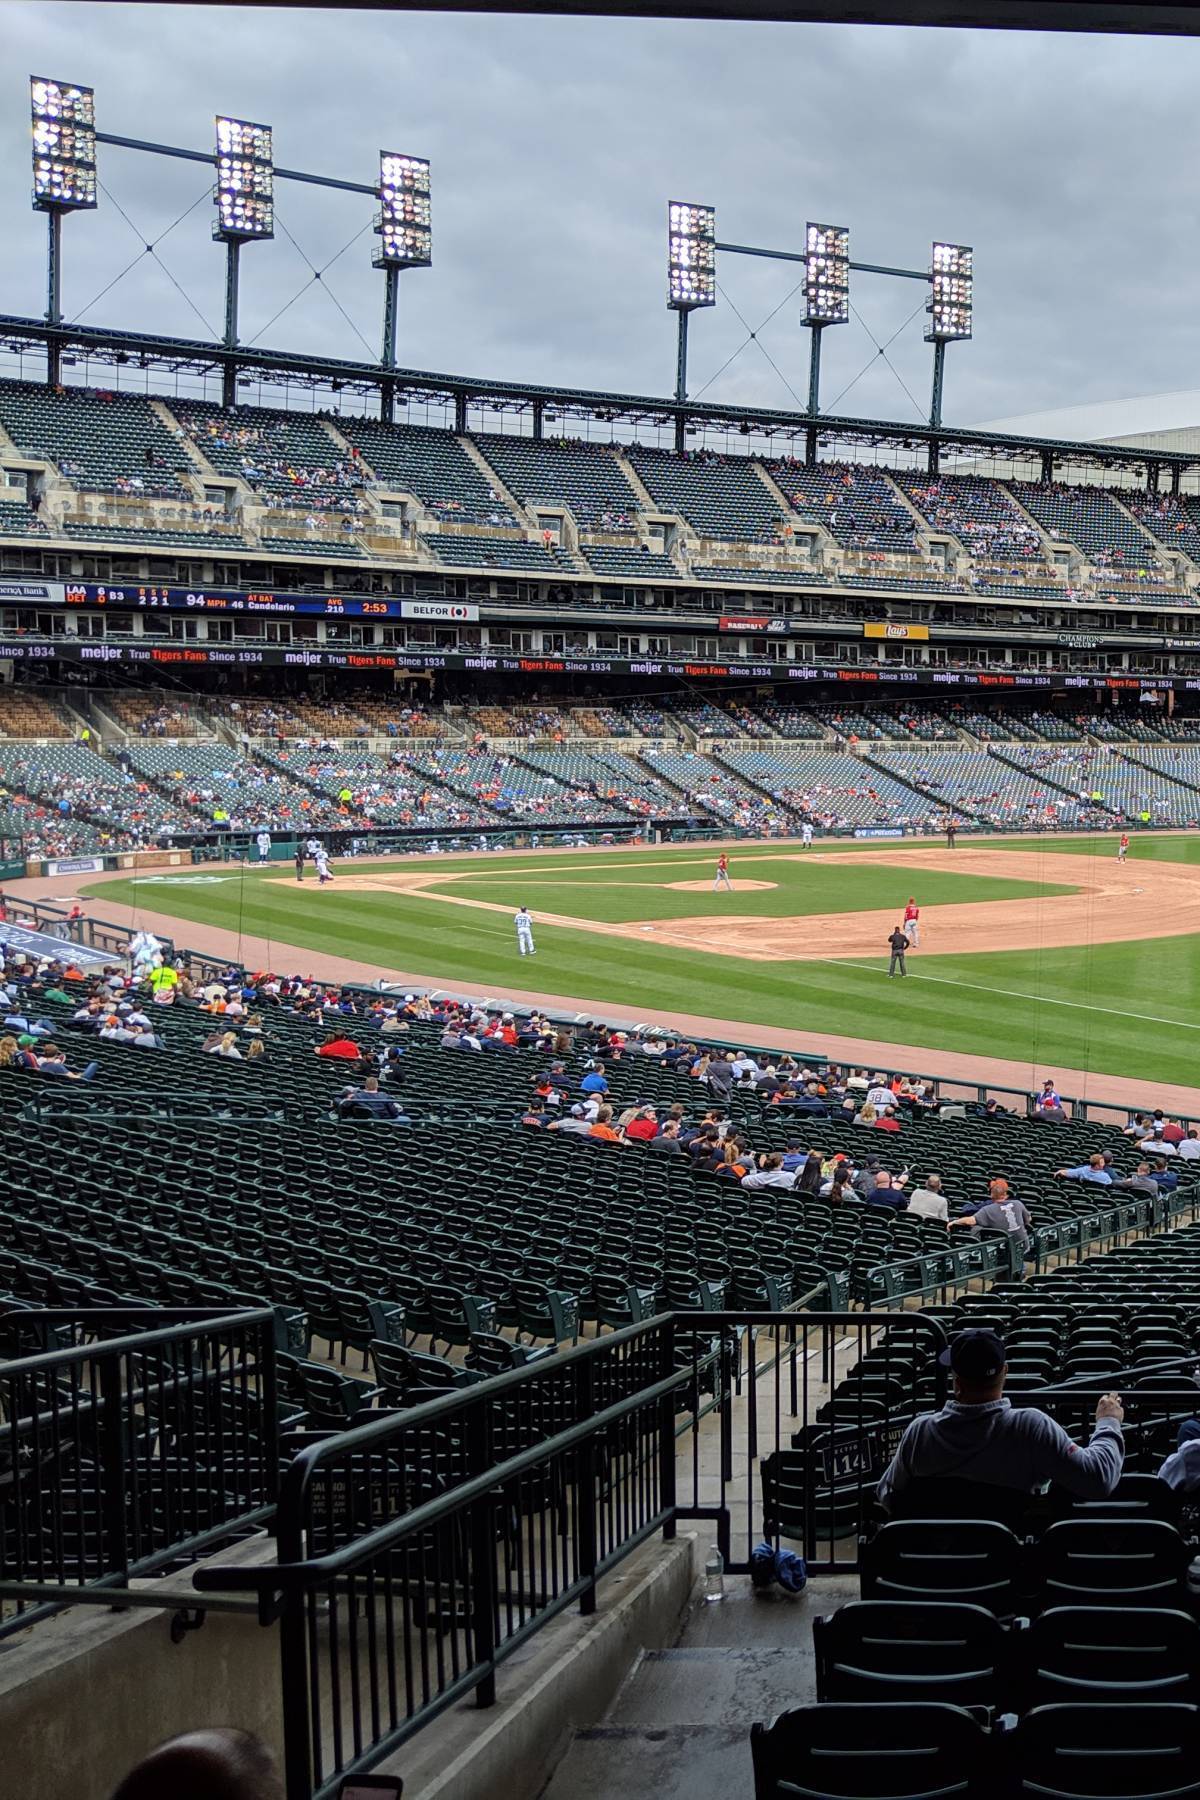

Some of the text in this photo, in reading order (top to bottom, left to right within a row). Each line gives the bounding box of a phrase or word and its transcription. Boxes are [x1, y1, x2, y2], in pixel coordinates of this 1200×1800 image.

[24, 587, 44, 595] Bank
[66, 586, 87, 594] LAA
[67, 594, 86, 603] DET
[109, 591, 125, 600] B3
[186, 594, 205, 606] 94
[151, 597, 158, 605] 2
[207, 599, 227, 607] MPH
[232, 601, 244, 609] 46
[248, 601, 295, 611] Candelario
[325, 605, 344, 613] .210
[362, 602, 388, 613] 2:53
[413, 606, 449, 615] BELFOR
[1059, 634, 1104, 643] CHAMPIONS
[81, 645, 263, 662] meijer True Tigers Fans Since 1934
[285, 651, 445, 666] meijer True Tigers Fans Since 1934
[631, 662, 771, 676] meijer True Tigers Fans Since 1934
